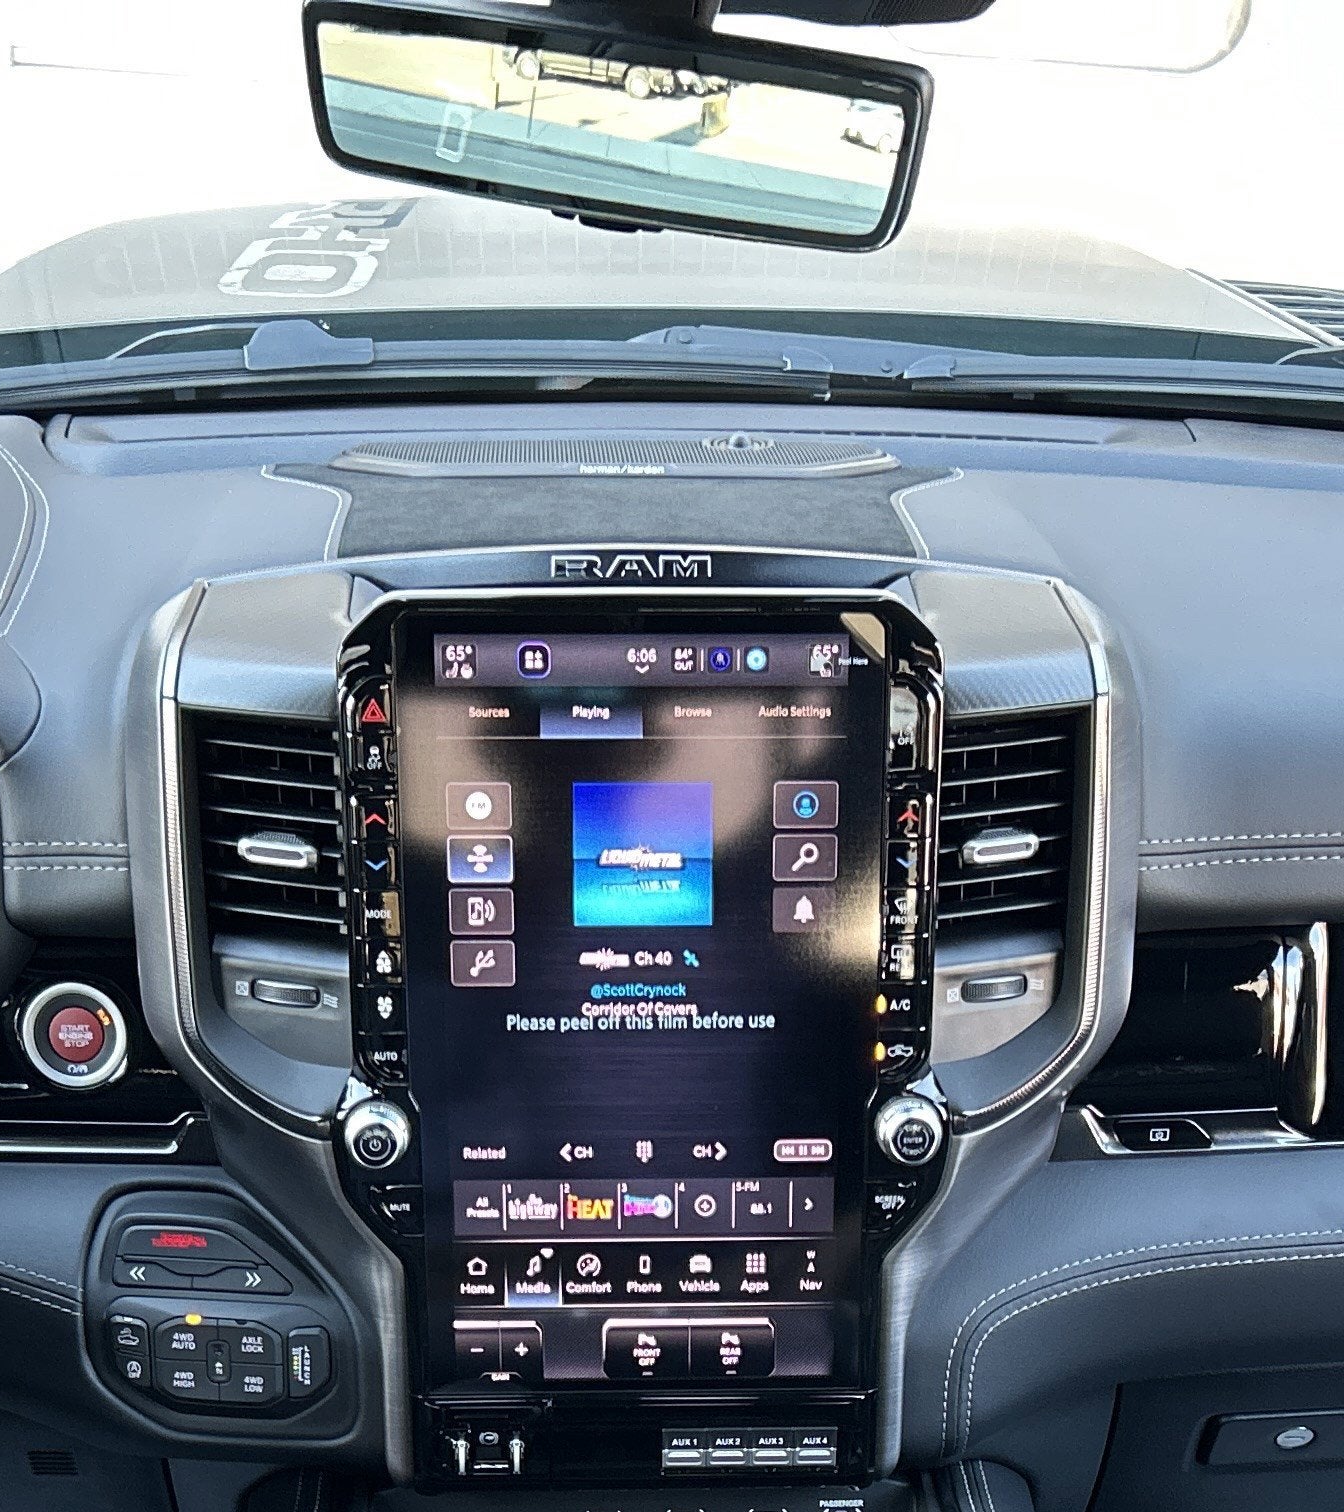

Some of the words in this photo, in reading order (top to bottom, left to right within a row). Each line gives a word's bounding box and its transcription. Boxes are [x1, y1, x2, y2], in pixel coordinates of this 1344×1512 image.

[551, 555, 712, 578] RAM
[626, 647, 657, 663] 6:06
[674, 660, 694, 671] OUT
[468, 706, 510, 718] Sources
[572, 705, 610, 720] Playing
[674, 706, 712, 718] Browse
[758, 705, 788, 718] Audio
[790, 706, 832, 720] Settings
[365, 909, 393, 919] MODE
[634, 950, 653, 966] Ch
[655, 950, 673, 966] 40
[637, 1001, 654, 1016] Of
[889, 998, 911, 1011] A/C
[506, 1013, 556, 1031] Please
[559, 1014, 594, 1033] peel
[597, 1014, 621, 1031] off
[625, 1014, 654, 1030] this
[657, 1013, 688, 1030] film
[692, 1011, 744, 1030] before
[748, 1015, 776, 1029] use
[60, 1024, 90, 1032] START
[63, 1040, 90, 1049] STOP
[374, 1051, 398, 1062] AUTO
[463, 1146, 507, 1159] Related
[574, 1145, 594, 1158] CH
[692, 1144, 712, 1158] CH
[476, 1196, 489, 1207] All
[389, 1203, 411, 1212] MUTE
[465, 1207, 500, 1218] Presets
[507, 1198, 558, 1220] highway
[567, 1199, 614, 1220] HEAT
[459, 1282, 495, 1294] Home
[515, 1281, 551, 1294] Media
[565, 1281, 612, 1294] Comfort
[626, 1281, 662, 1294] Phone
[678, 1279, 721, 1293] Vehicle
[740, 1279, 770, 1294] Apps
[799, 1278, 823, 1291] Nav
[172, 1331, 195, 1341] 4WD
[241, 1336, 263, 1345] AXLE
[171, 1341, 196, 1351] AUTO
[241, 1345, 264, 1354] LOCK
[632, 1348, 661, 1358] FRONT
[638, 1357, 657, 1367] OFF
[721, 1356, 739, 1366] OFF
[173, 1371, 194, 1380] 4WD
[243, 1376, 264, 1385] 4WD
[172, 1379, 195, 1389] HIGH
[244, 1384, 264, 1393] LOW
[672, 1438, 691, 1446] AUX
[715, 1438, 734, 1446] AUX
[758, 1437, 777, 1445] AUX
[802, 1436, 821, 1444] AUX
